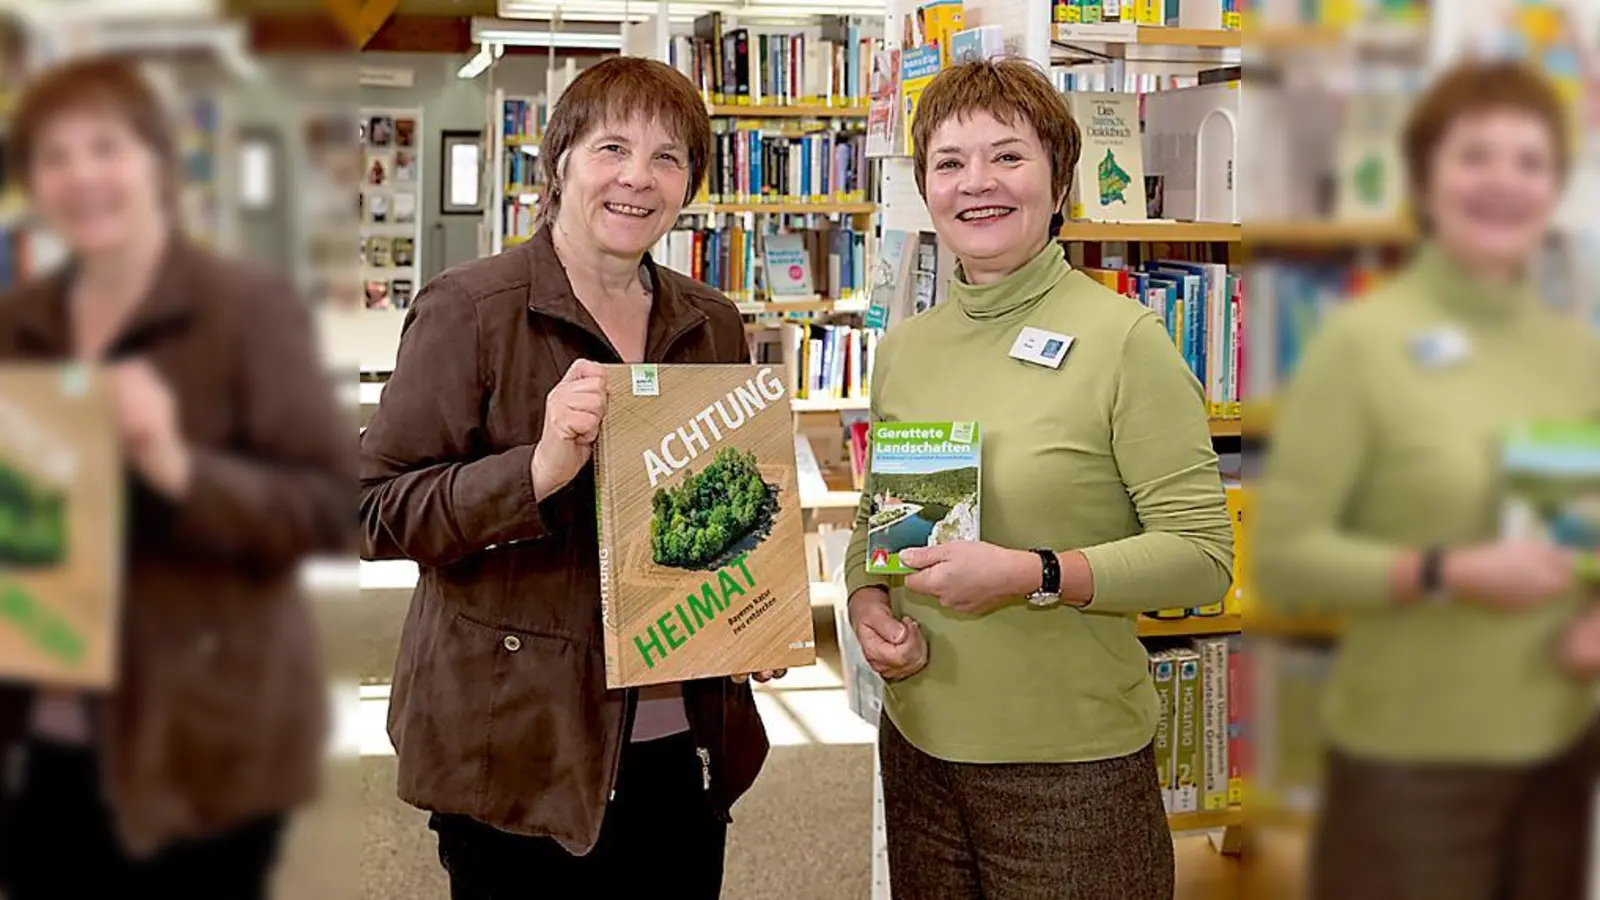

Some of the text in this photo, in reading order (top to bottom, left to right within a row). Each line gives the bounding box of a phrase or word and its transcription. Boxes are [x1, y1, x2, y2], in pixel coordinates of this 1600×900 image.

[1096, 105, 1115, 116] Das
[642, 367, 786, 487] ACHTUNG
[876, 427, 944, 439] Gerettete
[876, 441, 971, 454] Landschaften
[632, 552, 757, 669] HEIMAT
[727, 588, 772, 625] Bayerns Natur
[732, 596, 777, 635] neu entdecken
[1204, 665, 1215, 727] deutschen
[1216, 676, 1225, 699] und
[1182, 686, 1194, 746] DEUTSCH
[1178, 763, 1191, 779] 2
